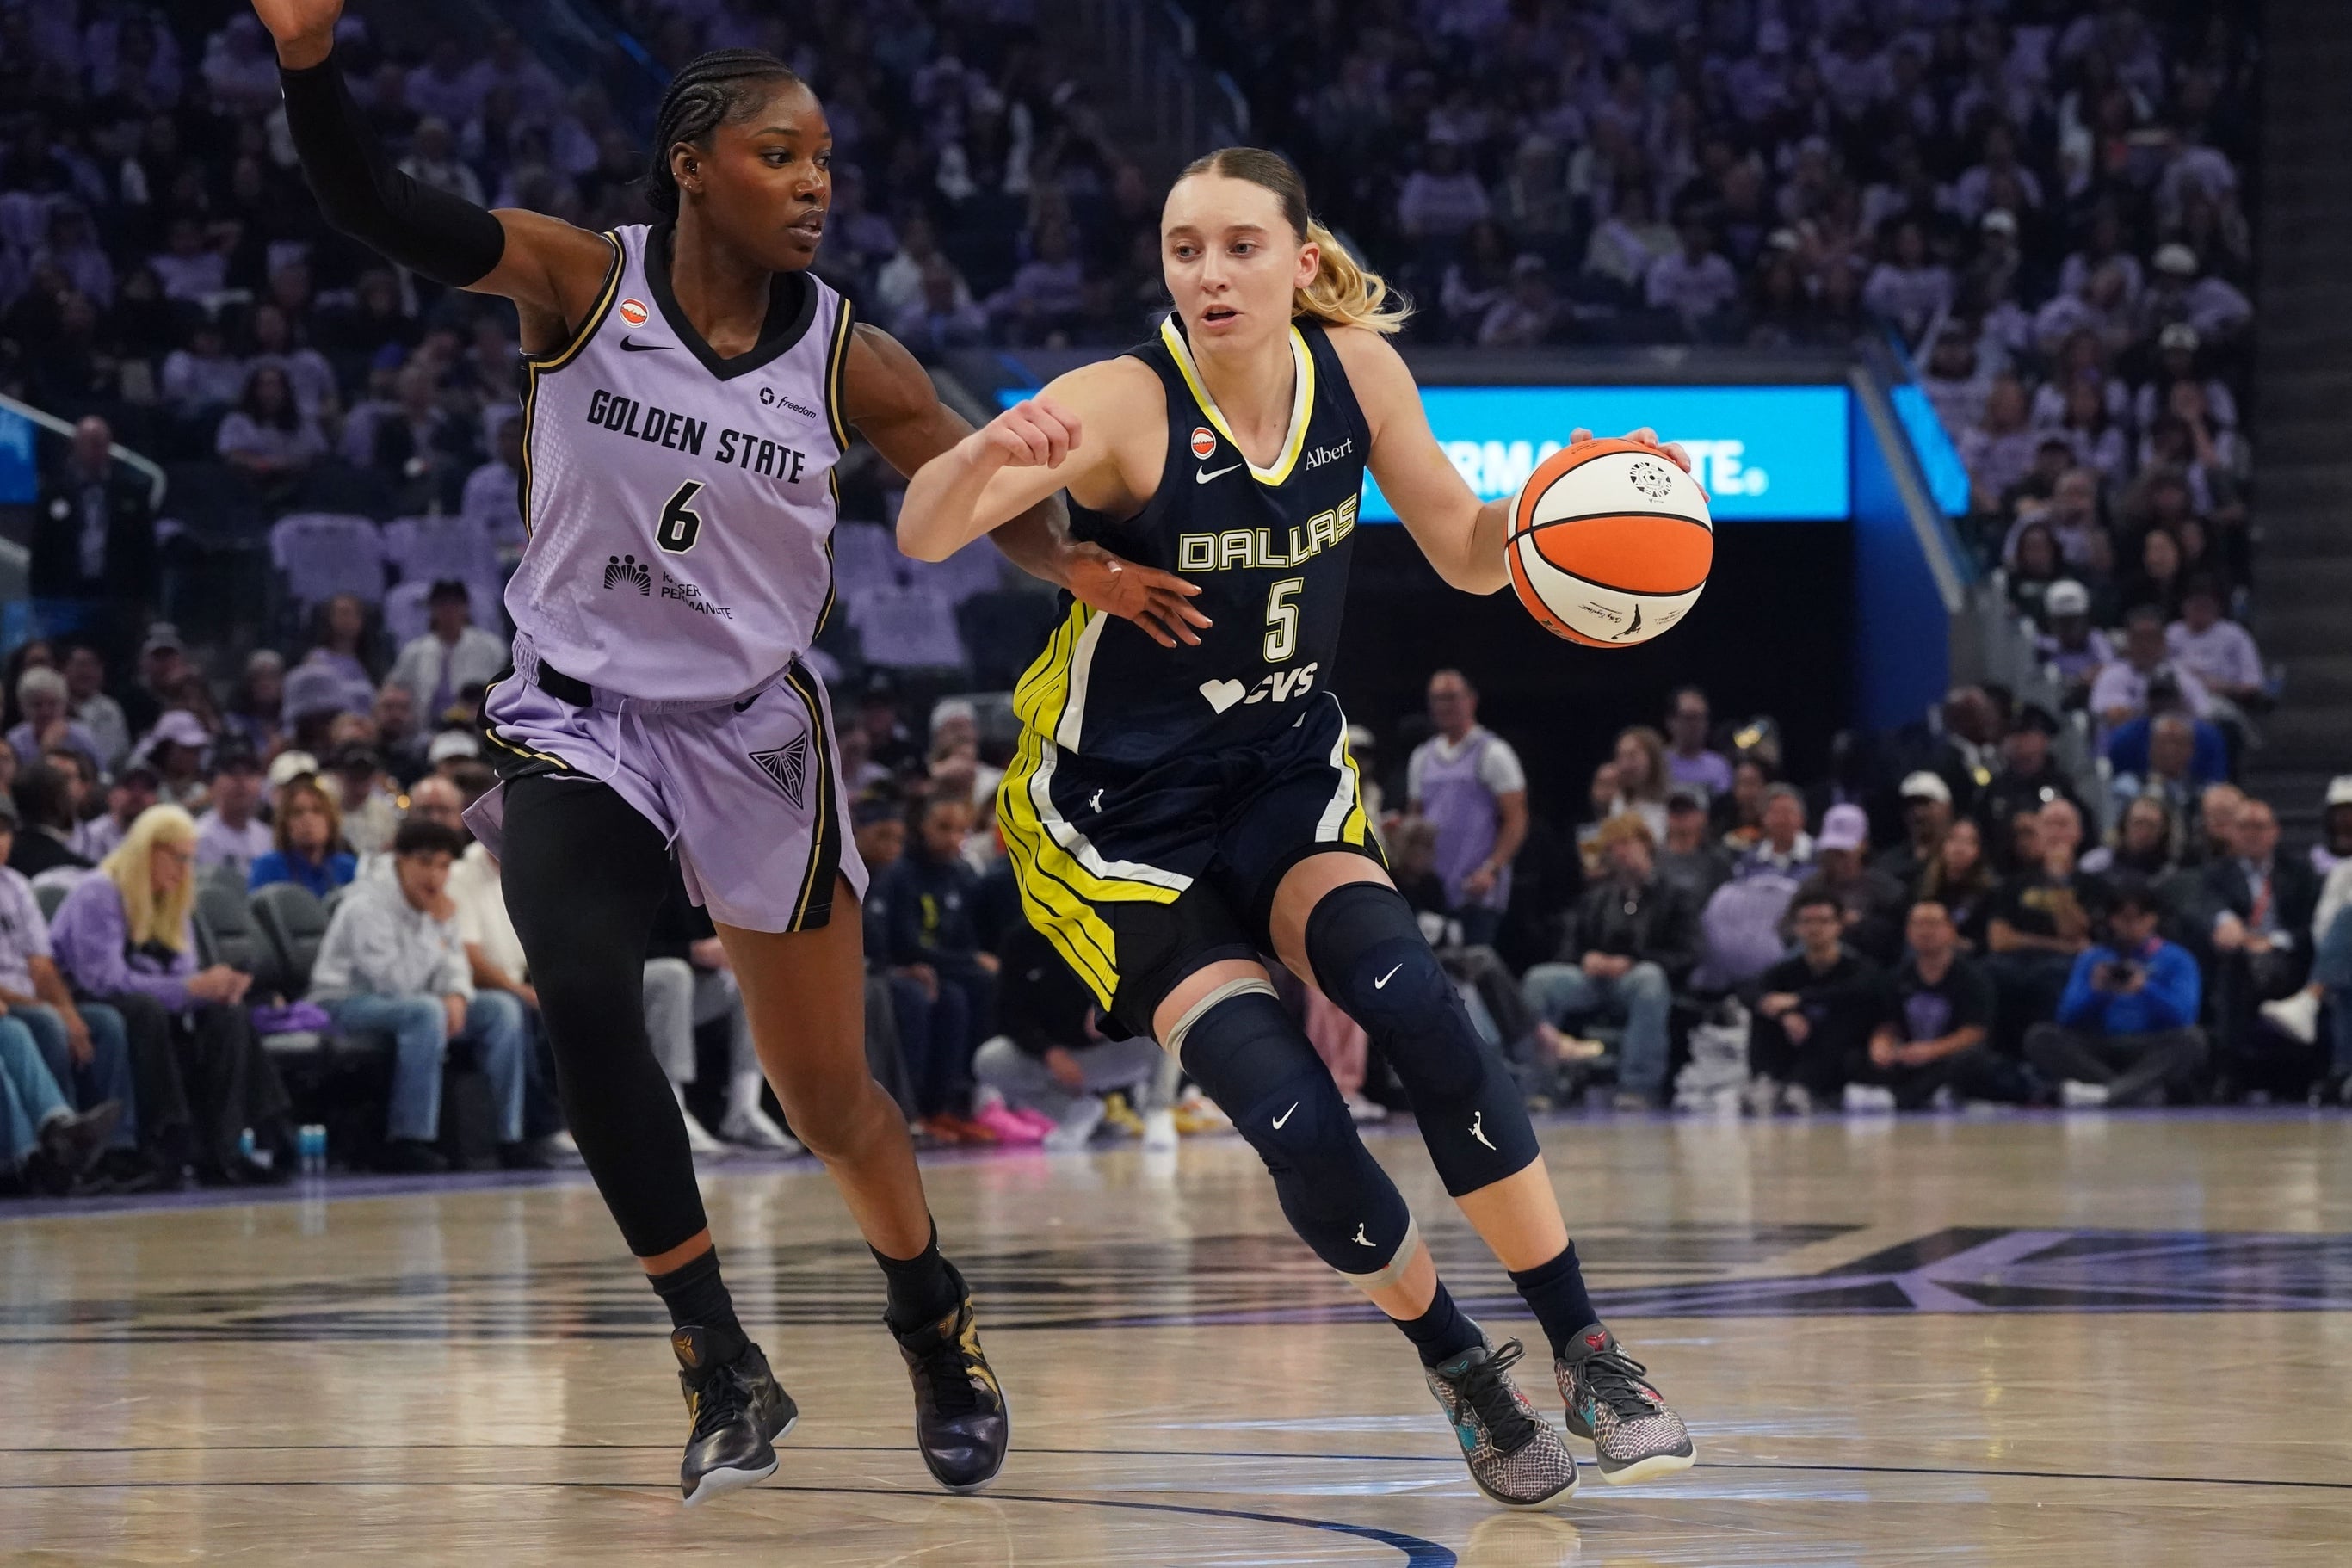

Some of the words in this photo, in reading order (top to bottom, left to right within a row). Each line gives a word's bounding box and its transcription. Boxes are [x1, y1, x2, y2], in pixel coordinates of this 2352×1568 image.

[586, 388, 707, 456] GOLDEN
[715, 429, 806, 484] STATE
[776, 396, 817, 419] freedom
[1305, 438, 1353, 471] Albert
[654, 478, 707, 555] 6
[1178, 492, 1358, 572] DALLAS
[662, 571, 701, 597] KSER
[1263, 577, 1305, 664] 5
[1244, 661, 1318, 704] CVS
